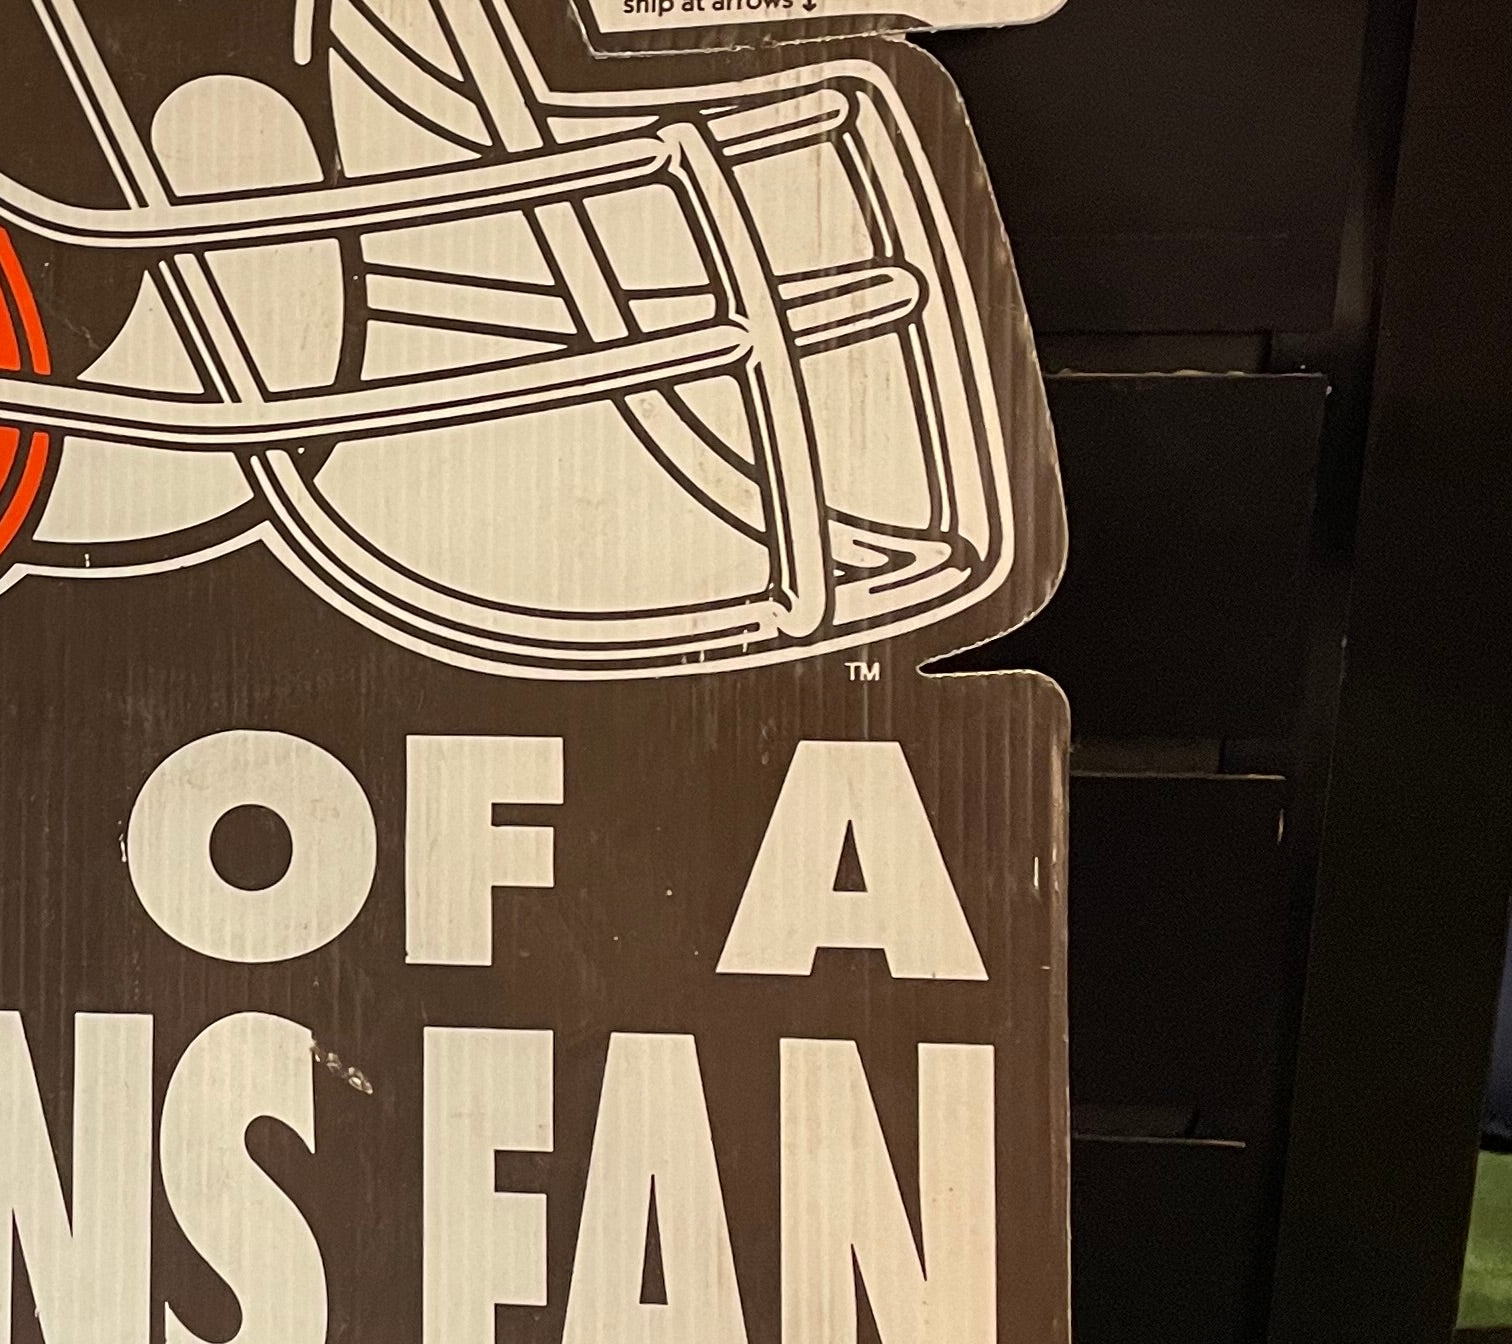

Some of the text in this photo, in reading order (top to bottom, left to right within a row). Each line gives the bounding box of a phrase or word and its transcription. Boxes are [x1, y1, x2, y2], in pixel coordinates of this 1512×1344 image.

[843, 661, 881, 681] TM
[125, 727, 565, 967] OF
[714, 739, 990, 982] A
